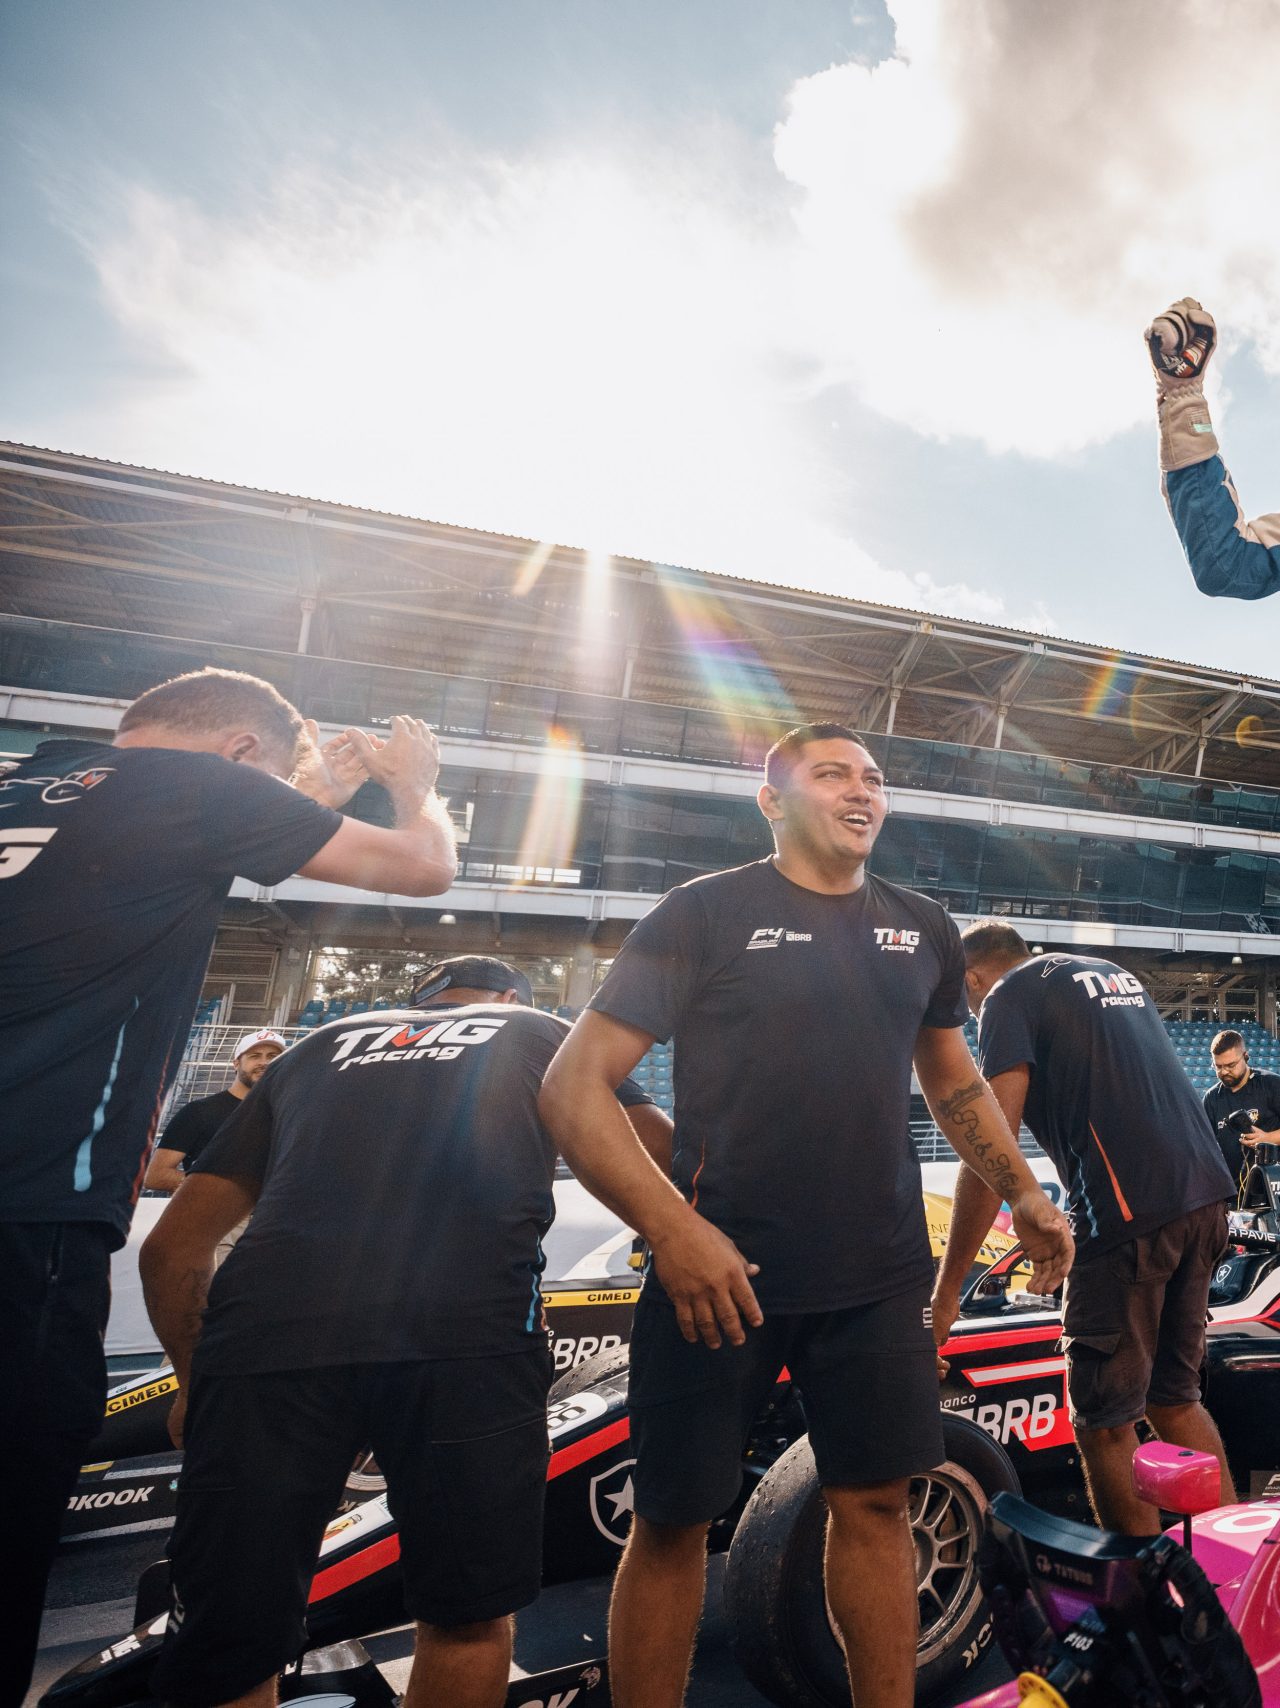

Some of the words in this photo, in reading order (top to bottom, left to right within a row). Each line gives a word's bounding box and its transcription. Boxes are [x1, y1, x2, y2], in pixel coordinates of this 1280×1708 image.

[751, 928, 784, 941] F4
[794, 933, 812, 942] BRB
[873, 927, 920, 945] TMG
[881, 944, 915, 954] racing
[1071, 970, 1144, 999] TMG
[1100, 995, 1146, 1008] racing
[330, 1017, 508, 1063] TMG
[337, 1045, 466, 1072] racing
[1239, 1230, 1277, 1243] PAVIE
[587, 1292, 632, 1302] CIMED
[107, 1382, 171, 1414] CIMED
[976, 1393, 1057, 1445] BRB
